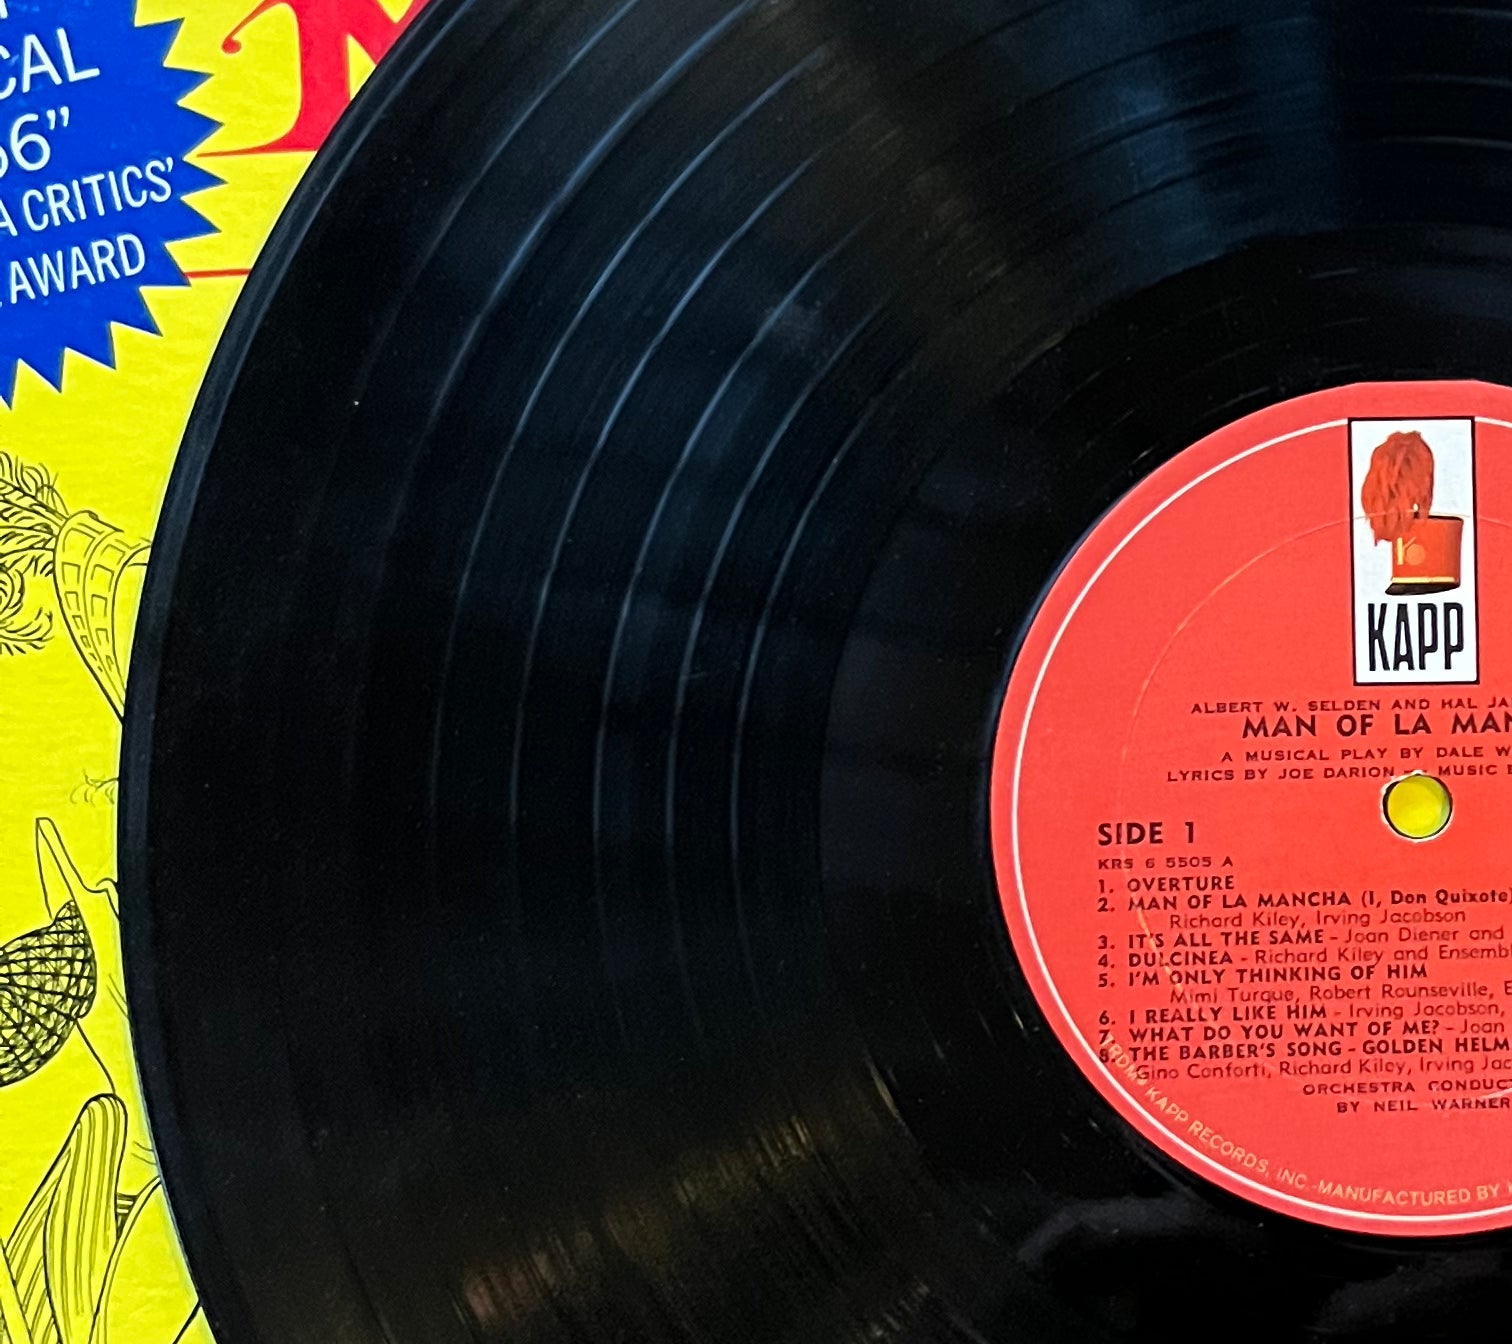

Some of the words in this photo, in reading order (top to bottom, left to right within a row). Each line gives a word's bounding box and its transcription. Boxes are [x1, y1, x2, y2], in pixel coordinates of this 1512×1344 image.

[22, 157, 175, 233] CRITICS'
[10, 232, 146, 305] AWARD
[1367, 602, 1464, 672] KAPP
[1191, 702, 1263, 714] ALBERT
[1274, 702, 1296, 712] W.
[1308, 700, 1380, 711] SELDEN
[1392, 699, 1429, 710] AND
[1442, 698, 1477, 709] HAL
[1242, 715, 1316, 738] MAN
[1337, 714, 1373, 737] OF
[1395, 713, 1432, 735] LA
[1222, 752, 1232, 762] A
[1246, 750, 1329, 762] MUSICAL
[1341, 748, 1387, 760] PLAY
[1400, 747, 1423, 758] BY
[1437, 747, 1483, 758] DALE
[1168, 770, 1234, 781] LYRICS
[1245, 768, 1267, 780] BY
[1279, 769, 1313, 779] JOE
[1324, 767, 1394, 778] DARION
[1439, 765, 1497, 776] MUSIC
[1098, 822, 1163, 846] SIDE
[1185, 822, 1194, 843] 1
[1099, 859, 1133, 869] KRS
[1146, 858, 1154, 868] 6
[1166, 857, 1211, 868] 5505
[1222, 856, 1233, 866] A
[1099, 879, 1113, 893] 1.
[1127, 875, 1234, 892] OVERTURE
[1098, 897, 1114, 912] 2.
[1128, 896, 1176, 911] MAN
[1188, 895, 1212, 909] OF
[1223, 894, 1247, 908] LA
[1258, 891, 1351, 908] MANCHA
[1362, 891, 1381, 908] (I,
[1391, 890, 1426, 904] Don
[1170, 913, 1242, 928] Richard
[1253, 912, 1305, 929] Kiley,
[1317, 910, 1370, 927] Irving
[1381, 909, 1465, 923] Jacobson
[1098, 935, 1114, 949] 3.
[1129, 933, 1164, 948] IT'S
[1174, 933, 1212, 947] ALL
[1220, 931, 1259, 946] THE
[1269, 929, 1323, 945] SAME
[1345, 929, 1388, 943] Joan
[1399, 927, 1458, 941] Diener
[1469, 927, 1504, 940] and
[1098, 954, 1114, 968] 4.
[1255, 948, 1327, 963] Richard
[1338, 947, 1384, 966] Kiley
[1394, 946, 1428, 960] and
[1098, 973, 1114, 987] 5.
[1129, 971, 1159, 986] I'M
[1169, 969, 1225, 985] ONLY
[1236, 966, 1340, 983] THINKING
[1351, 965, 1376, 981] OF
[1388, 963, 1427, 979] HIM
[1228, 988, 1299, 1003] Turque,
[1310, 985, 1370, 1000] Robert
[1382, 982, 1493, 999] Rounseville,
[1099, 1010, 1115, 1025] 6.
[1130, 1010, 1134, 1024] I
[1146, 1007, 1222, 1024] REALLY
[1233, 1005, 1276, 1021] LIKE
[1287, 1004, 1326, 1019] HIM
[1350, 1005, 1403, 1019] Irving
[1415, 1002, 1504, 1016] Jacobson,
[1099, 1029, 1115, 1044] 7.
[1129, 1027, 1193, 1042] WHAT
[1204, 1026, 1231, 1040] DO
[1241, 1024, 1283, 1039] YOU
[1294, 1022, 1358, 1037] WANT
[1368, 1021, 1391, 1036] OF
[1403, 1020, 1439, 1034] ME?
[1462, 1020, 1504, 1033] Joan
[1129, 1046, 1169, 1062] THE
[1180, 1043, 1275, 1060] BARBER'S
[1287, 1041, 1341, 1057] SONG
[1363, 1039, 1442, 1054] GOLDEN
[1135, 1065, 1178, 1079] Gino
[1187, 1062, 1270, 1078] Conforti,
[1280, 1060, 1351, 1075] Richard
[1360, 1059, 1411, 1075] Kiley,
[1421, 1057, 1473, 1073] Irving
[1303, 1082, 1415, 1095] ORCHESTRA
[1337, 1101, 1359, 1113] BY
[1374, 1100, 1418, 1112] NEIL
[1432, 1097, 1510, 1110] WARNER
[1145, 1087, 1189, 1122] KAPP
[1188, 1119, 1271, 1178] RECORDS,
[1476, 1183, 1500, 1201] BY
